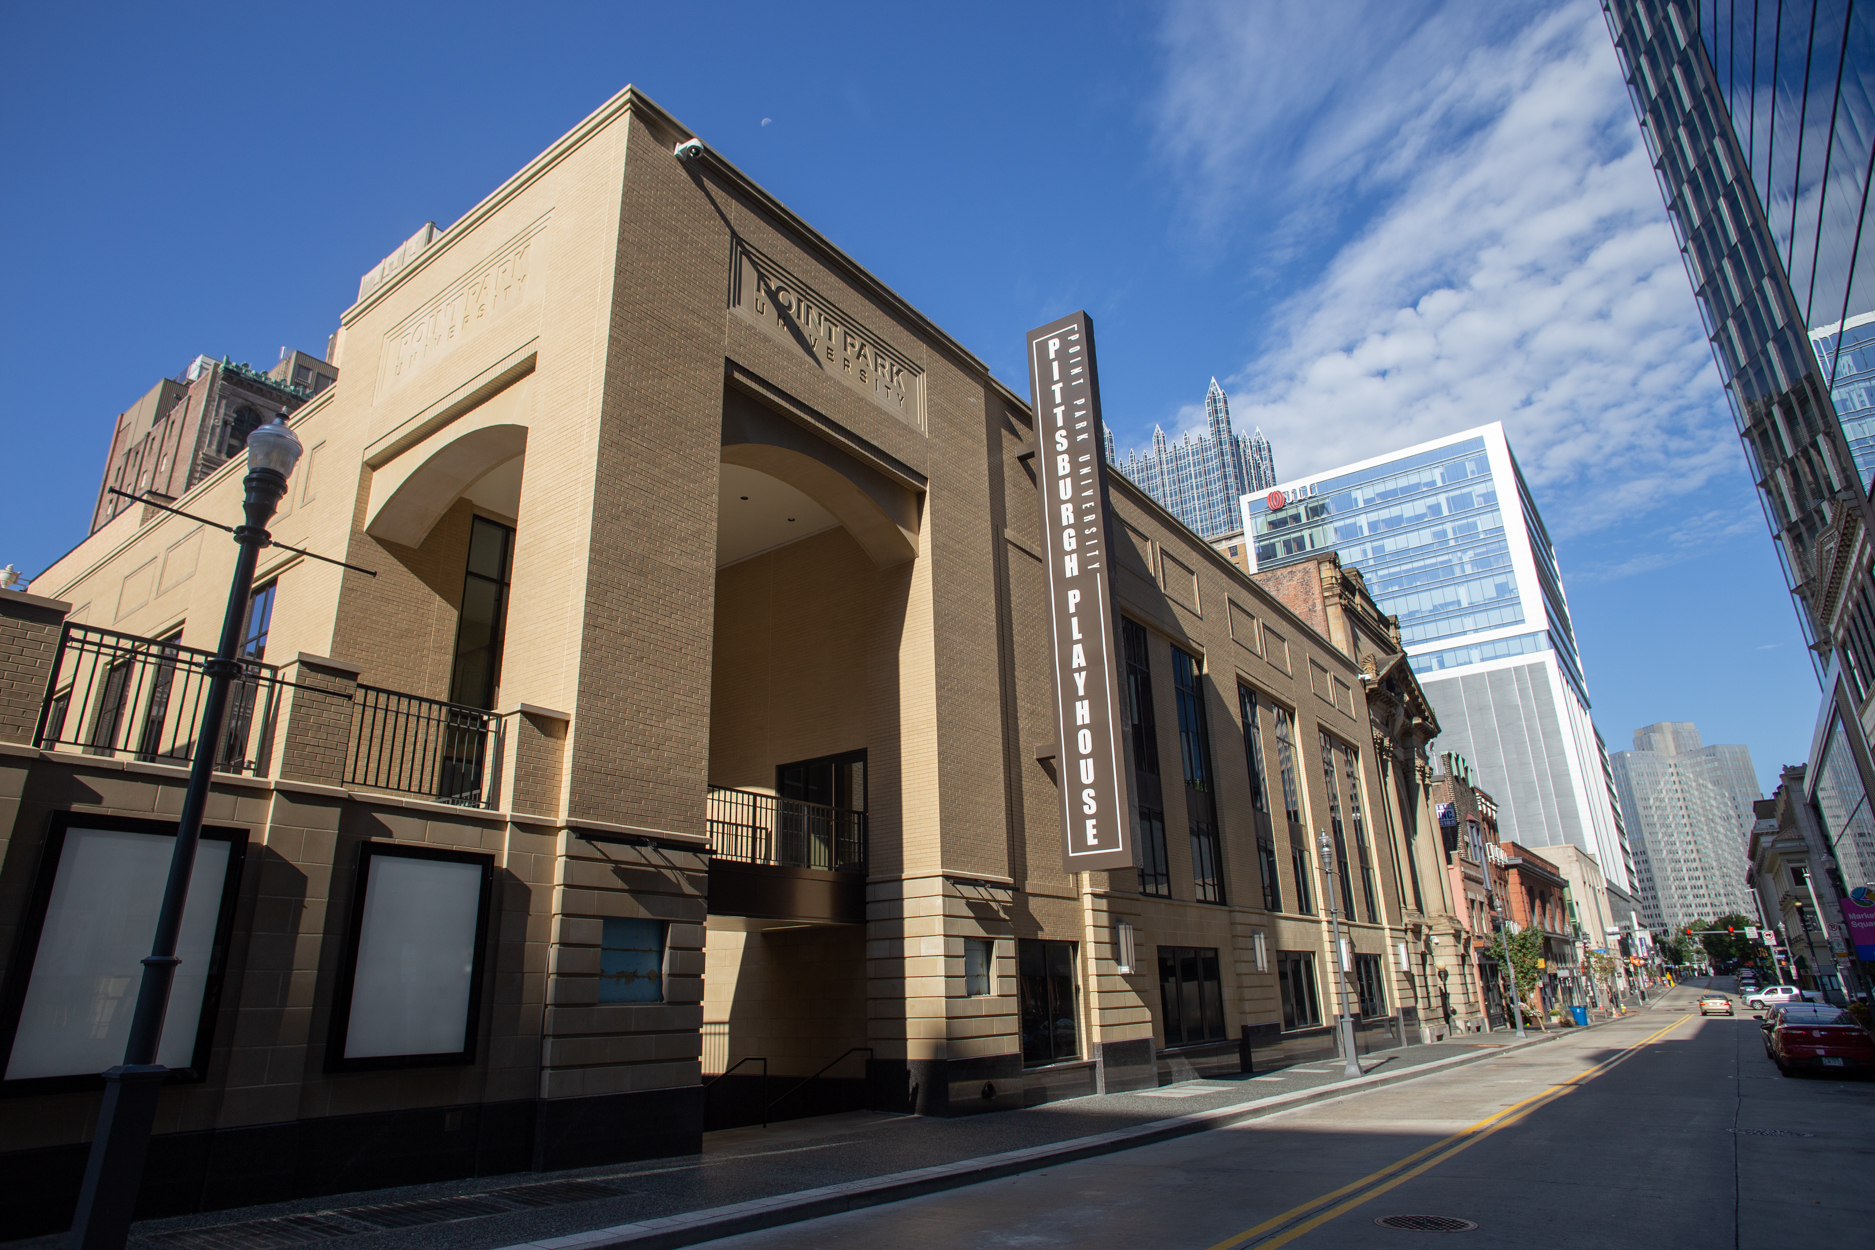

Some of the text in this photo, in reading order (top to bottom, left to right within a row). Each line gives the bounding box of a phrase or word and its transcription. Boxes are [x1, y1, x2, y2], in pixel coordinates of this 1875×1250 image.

[754, 297, 906, 409] UNIVERSITY
[756, 270, 907, 392] POINT PARK
[1066, 332, 1101, 570] POINT PARK UNIVERSITY
[1047, 336, 1099, 847] PITTSBURGH PLAYHOUSE
